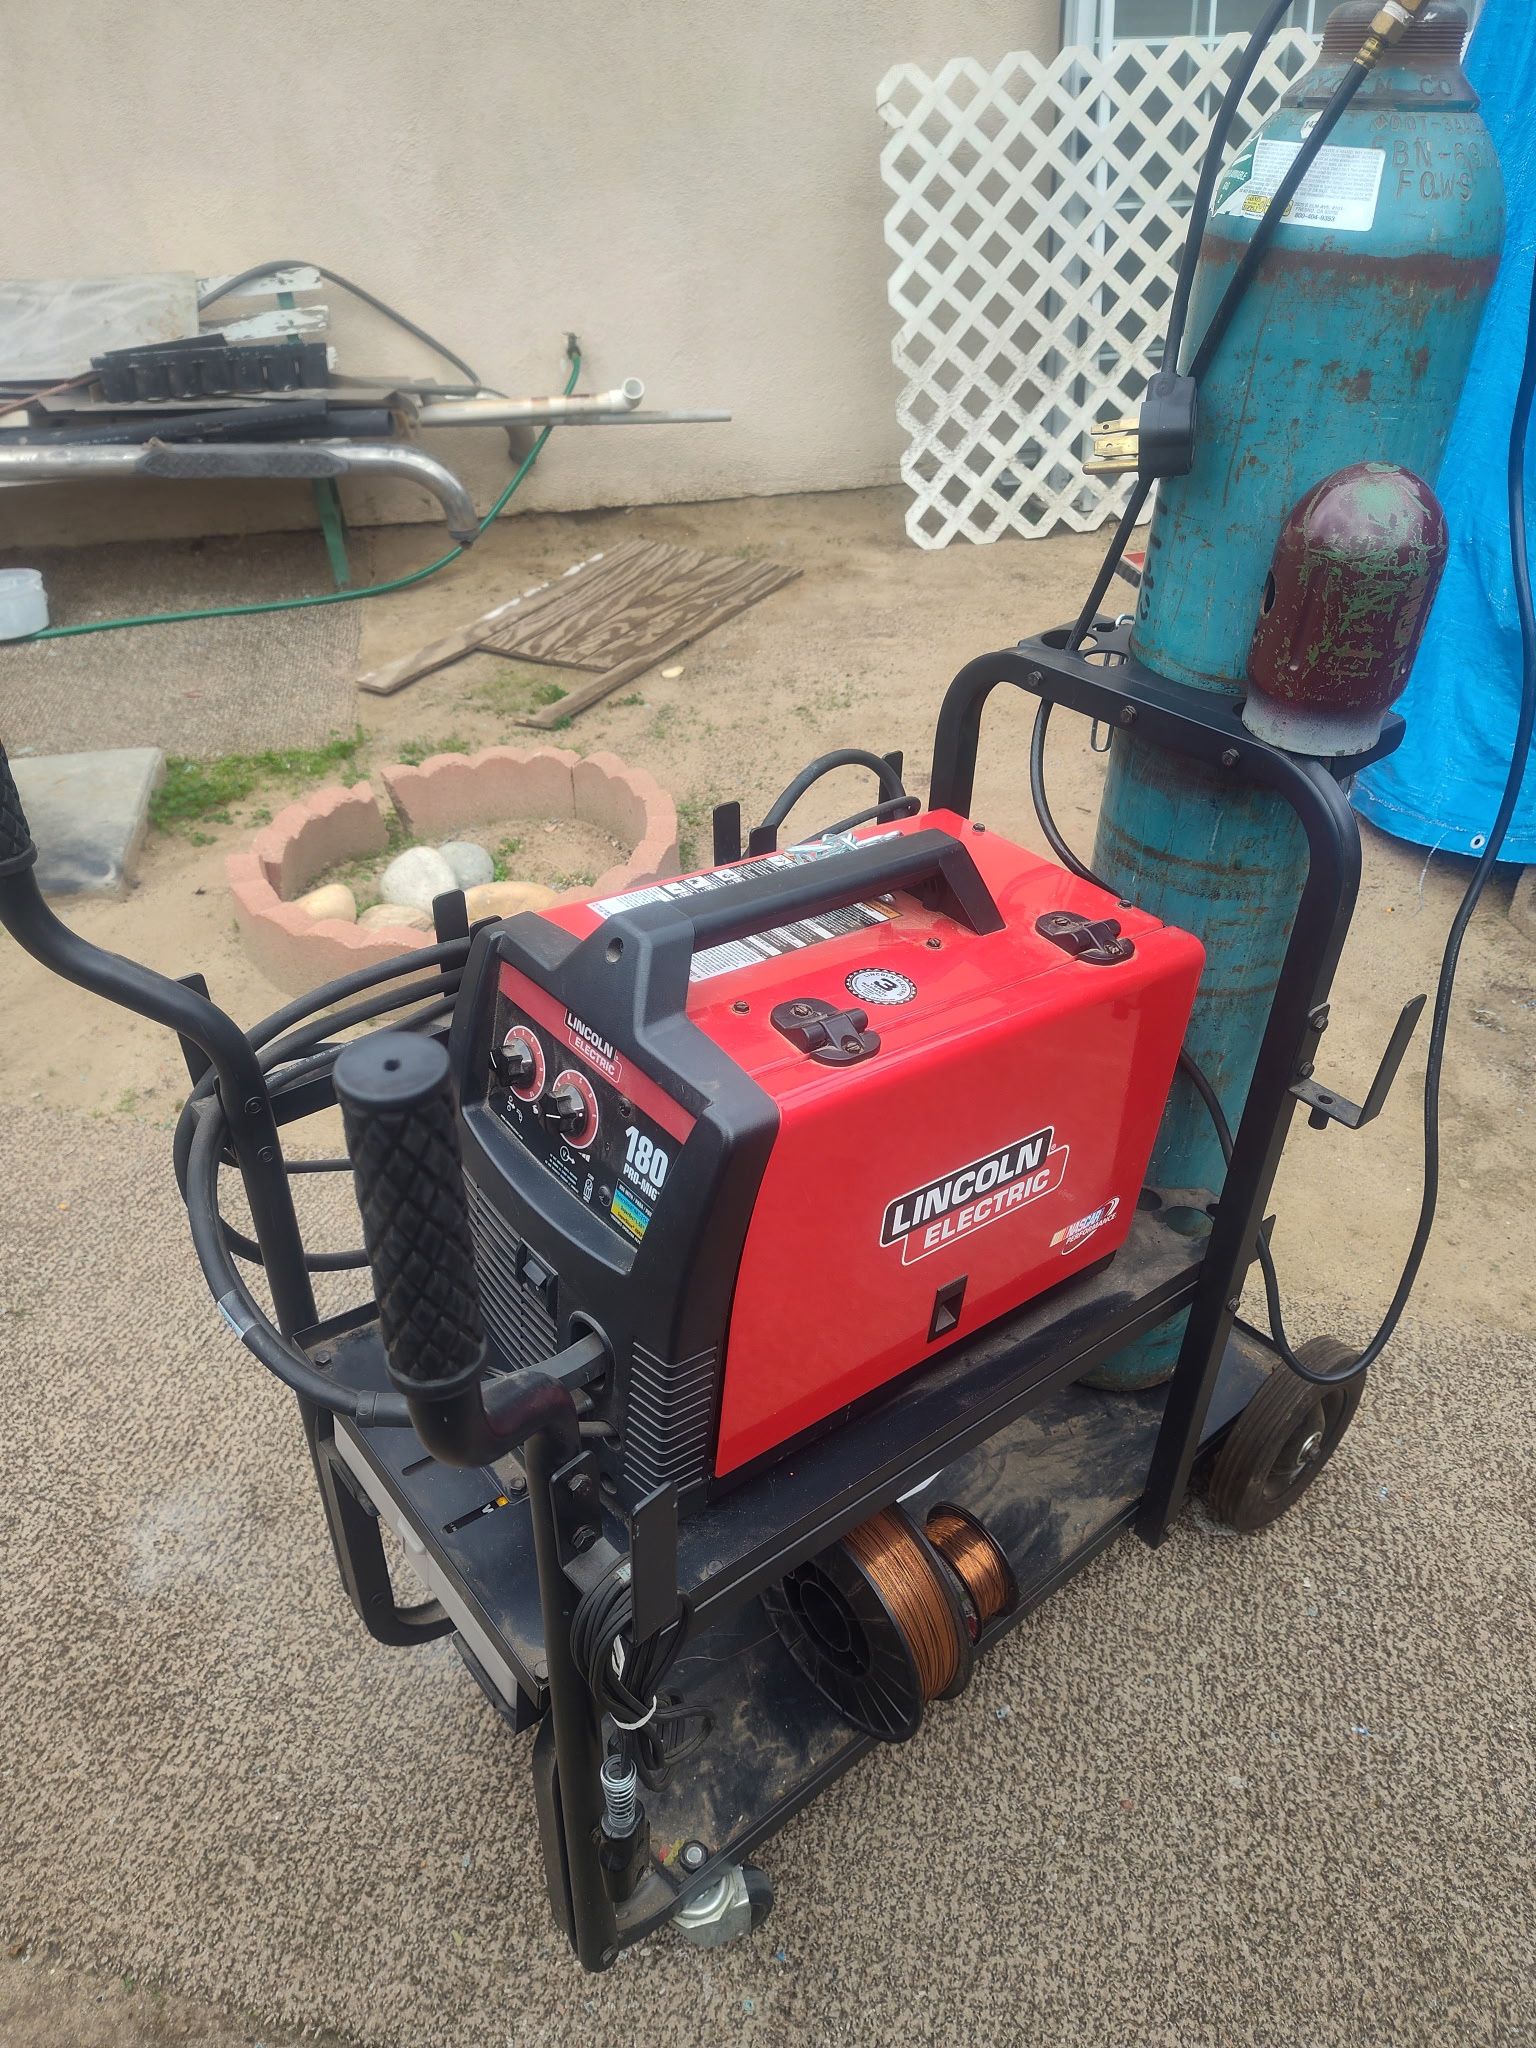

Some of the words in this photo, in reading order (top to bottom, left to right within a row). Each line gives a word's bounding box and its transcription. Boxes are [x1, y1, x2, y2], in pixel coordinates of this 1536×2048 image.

[566, 1011, 614, 1059] LINCOLN
[574, 1037, 616, 1077] ELECTRIC
[625, 1125, 669, 1188] 180
[622, 1161, 659, 1202] PRO-MIG
[891, 1138, 1044, 1236] LINCOLN
[923, 1167, 1051, 1250] ELECTRIC
[1065, 1207, 1105, 1239] NASCAR
[1065, 1212, 1118, 1246] PERFORMANCE
